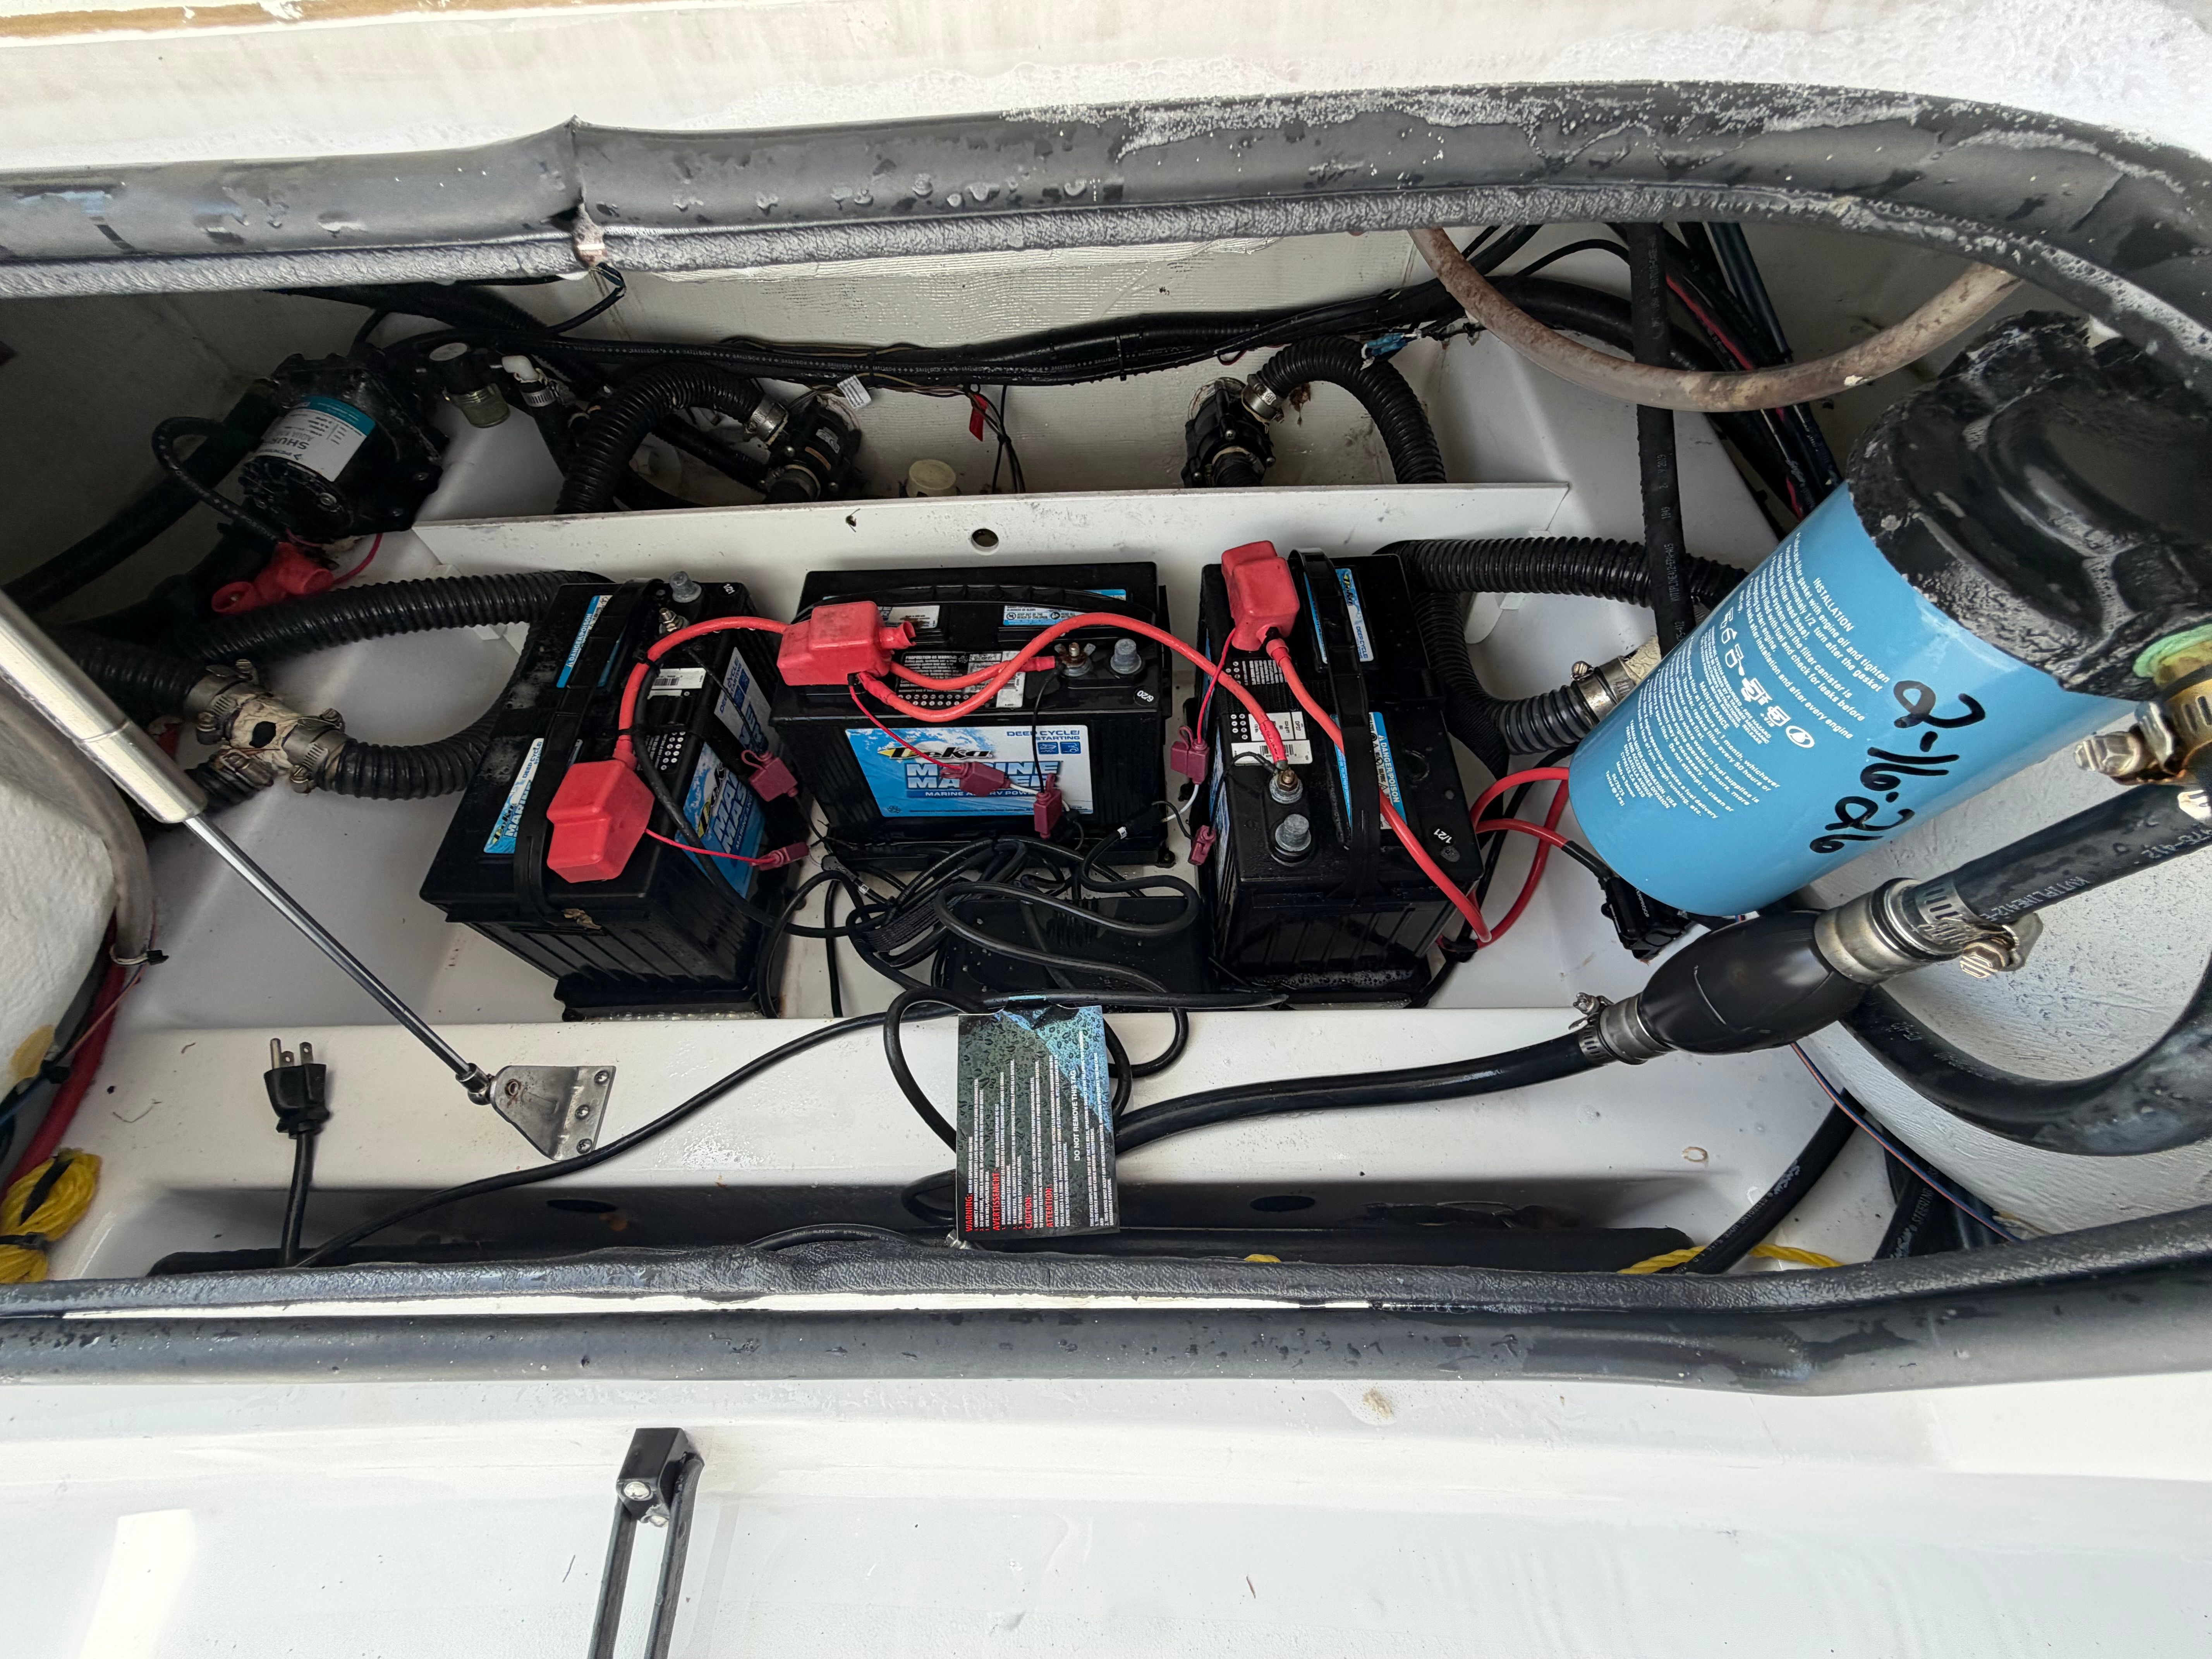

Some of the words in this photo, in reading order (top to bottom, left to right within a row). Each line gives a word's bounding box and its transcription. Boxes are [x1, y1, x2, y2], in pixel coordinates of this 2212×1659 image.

[722, 582, 735, 595] 1/21
[1762, 596, 1773, 615] filled
[1812, 577, 1855, 632] INSTALLATION
[569, 612, 592, 662] DANGER/POISON
[1767, 613, 1778, 629] with
[1774, 627, 1787, 642] fuel
[1785, 600, 1798, 619] head
[1793, 617, 1810, 640] base).
[1797, 577, 1813, 600] gasket
[1808, 598, 1822, 615] with
[1818, 614, 1840, 638] engine
[1837, 637, 1851, 647] oil
[1846, 646, 1864, 661] and
[1860, 658, 1890, 683] tighten
[1762, 627, 1777, 653] engine.
[1772, 597, 1786, 622] system
[1782, 620, 1796, 637] until
[1791, 635, 1803, 649] the
[1800, 646, 1817, 665] filter
[1814, 664, 1845, 691] canister
[1842, 689, 1853, 698] is
[1781, 641, 1796, 655] and
[1804, 613, 1817, 627] 1/2
[1813, 627, 1828, 643] turn
[1825, 642, 1844, 659] after
[1841, 657, 1856, 671] the
[1852, 669, 1883, 692] gasket
[1750, 623, 1760, 639] after
[1755, 636, 1781, 675] installation
[1778, 674, 1793, 688] and
[1789, 686, 1807, 702] after
[1804, 702, 1827, 720] every
[1825, 719, 1853, 739] engine
[1790, 654, 1811, 676] check
[1808, 673, 1820, 685] for
[1137, 690, 1154, 702] 6/20
[1699, 681, 1730, 730] MAINTENANCE
[1817, 682, 1839, 702] leaks
[1837, 699, 1865, 721] before
[1682, 721, 1695, 740] where
[1693, 740, 1709, 757] water
[1707, 757, 1714, 765] in
[1712, 763, 1727, 776] fuel
[1724, 775, 1752, 798] supplies
[1692, 708, 1709, 732] replace
[1706, 730, 1720, 745] filter
[1717, 745, 1735, 763] every
[1733, 761, 1745, 771] 50
[1742, 769, 1762, 786] hours
[1698, 701, 1705, 710] 10
[1702, 709, 1716, 728] hours
[1723, 739, 1743, 761] month,
[1744, 760, 1781, 788] whichever
[521, 761, 533, 779] DEEP
[1380, 742, 1400, 803] DANGER/POISON
[1631, 753, 1653, 787] ACCESSORIES
[1650, 786, 1670, 809] DIVISION
[1633, 740, 1644, 759] MOTOR
[1640, 758, 1666, 794] CORPORATION
[1666, 795, 1677, 807] USA
[1668, 742, 1676, 752] Do
[1673, 752, 1683, 763] not
[1681, 763, 1702, 786] attempt
[1707, 791, 1726, 807] clean
[1674, 722, 1687, 743] engine
[1685, 742, 1709, 771] operation
[1708, 771, 1730, 792] occurs,
[1731, 791, 1750, 805] more
[1623, 779, 1636, 798] Taiwan
[1637, 777, 1653, 798] AVENUE
[1662, 760, 1682, 786] indicates
[1684, 788, 1697, 800] fuel
[1694, 799, 1718, 819] delivery
[1668, 781, 1689, 805] running,
[1690, 805, 1701, 816] etc.
[1432, 827, 1454, 844] 1/21
[1073, 1150, 1080, 1161] DO
[964, 1194, 974, 1231] WARNING:
[991, 1173, 1001, 1230] AVERTISSEMENT
[1024, 1194, 1032, 1229] CAUTION:
